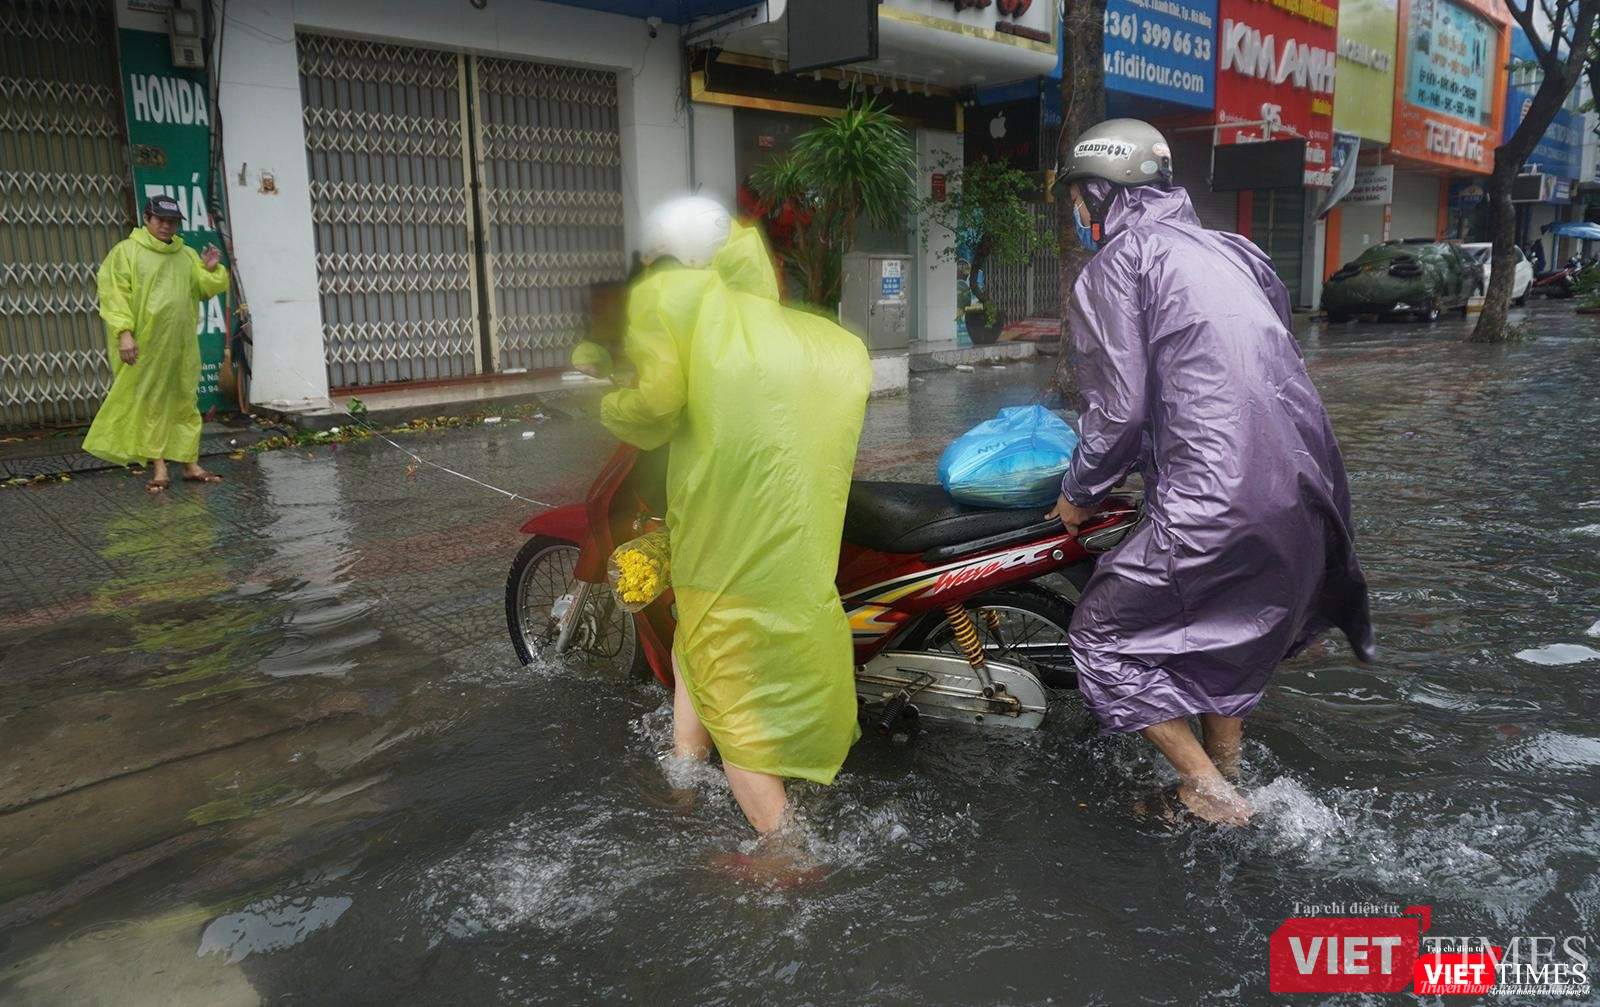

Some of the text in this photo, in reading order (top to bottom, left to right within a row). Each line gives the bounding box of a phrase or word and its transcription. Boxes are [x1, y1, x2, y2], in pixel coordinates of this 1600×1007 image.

[1142, 20, 1171, 50] 399
[1173, 30, 1191, 56] 66
[1194, 36, 1211, 61] 33
[1221, 18, 1336, 94] KIM ANH
[130, 72, 209, 126] HONDA
[1261, 102, 1282, 133] 95
[1077, 143, 1129, 157] DEADPOOL
[144, 171, 217, 233] THÁ
[932, 559, 1007, 595] Wave
